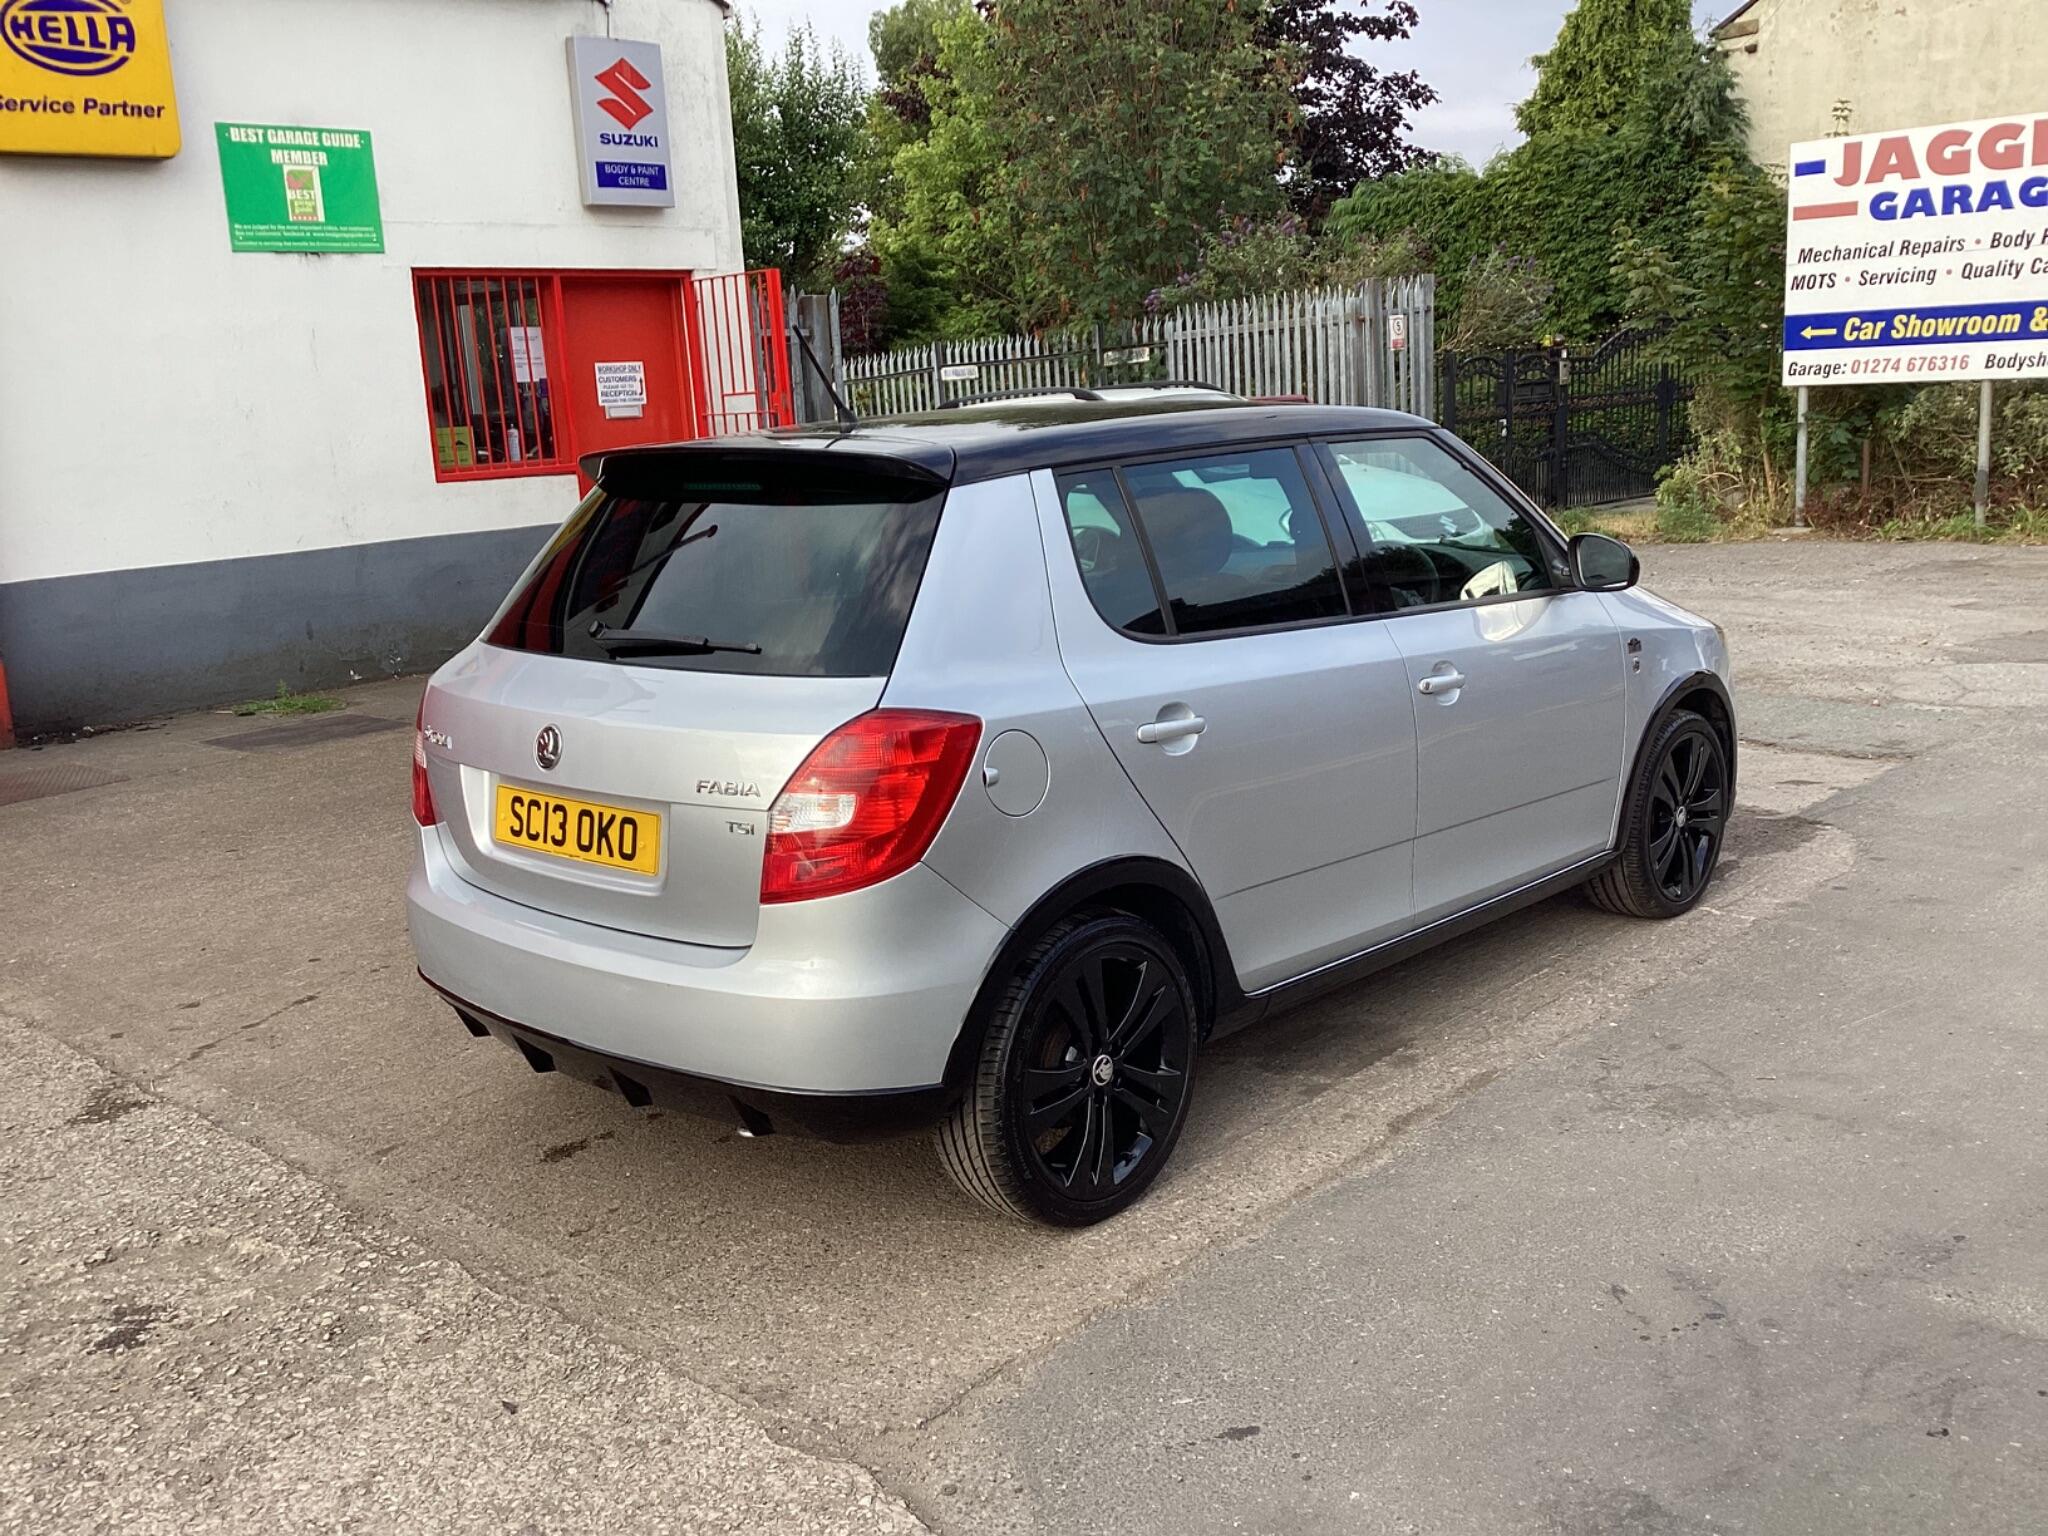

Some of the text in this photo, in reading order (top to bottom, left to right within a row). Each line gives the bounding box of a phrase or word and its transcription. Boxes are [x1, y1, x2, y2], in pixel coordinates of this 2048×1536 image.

[10, 15, 136, 53] HELLA
[0, 95, 165, 118] ervice Partner
[229, 127, 362, 148] BEST GARAGE GUIDE
[600, 133, 658, 147] SUZUKI
[270, 149, 328, 166] MEMBER
[604, 164, 659, 175] BODY & PAINT
[618, 176, 650, 186] CENTRE
[289, 189, 315, 200] BEST
[1797, 241, 1894, 264] Mechanical
[1900, 236, 1966, 258] Repairs
[1990, 229, 2035, 250] Body
[1790, 272, 1837, 291] MOTS
[1858, 266, 1937, 286] Servicing
[1961, 259, 2024, 281] Quality
[1843, 317, 1886, 342] Car
[1890, 312, 2021, 339] Showroom
[1788, 351, 2048, 379] Garage: 01274 676316 Bodysh
[599, 375, 637, 383] CUSTOMERS
[601, 390, 637, 398] RECEPTION
[696, 780, 761, 798] FABIA
[509, 795, 638, 862] SC13 OKO
[725, 821, 755, 836] TSI
